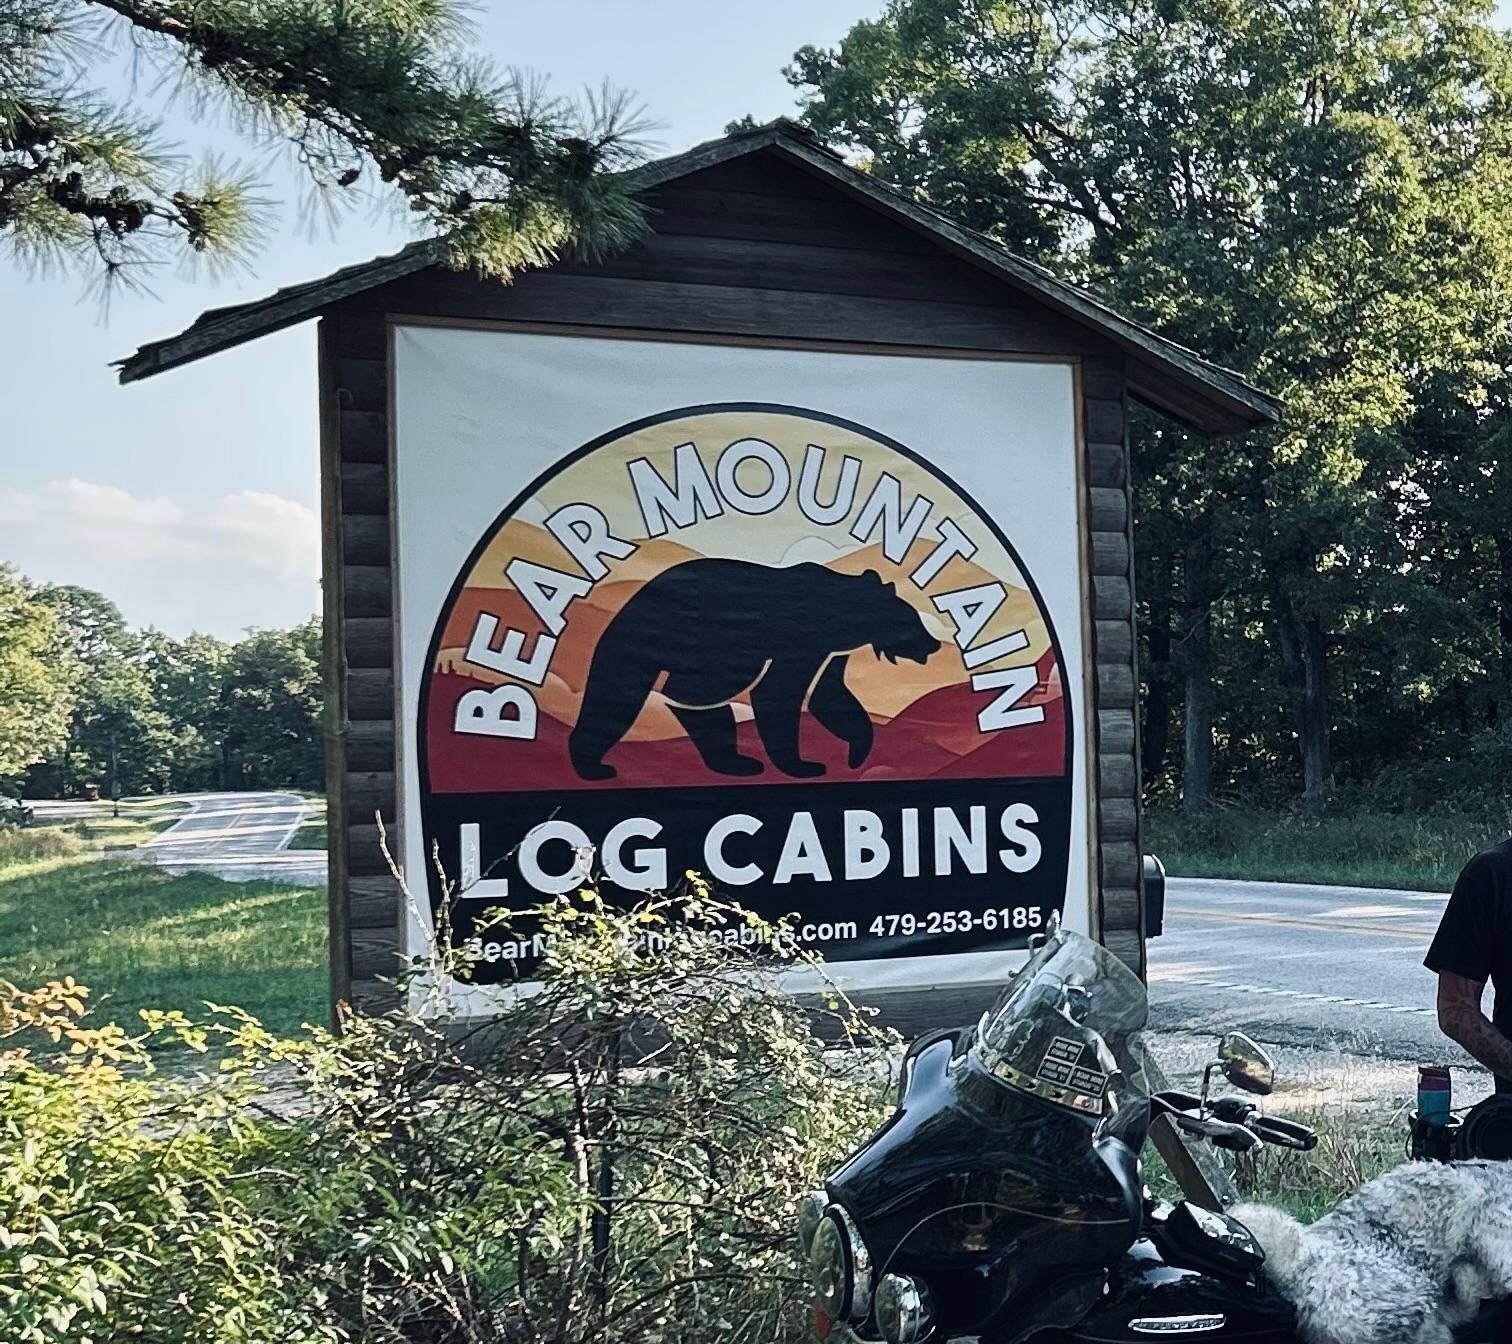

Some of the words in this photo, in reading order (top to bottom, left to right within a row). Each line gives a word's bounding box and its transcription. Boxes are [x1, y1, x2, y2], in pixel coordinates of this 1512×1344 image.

[453, 501, 640, 740] BEAR
[626, 437, 1046, 734] MOUNTAIN
[458, 817, 668, 898] LOG
[703, 803, 1042, 885] CABINS
[868, 906, 1042, 937] 479-253-6185
